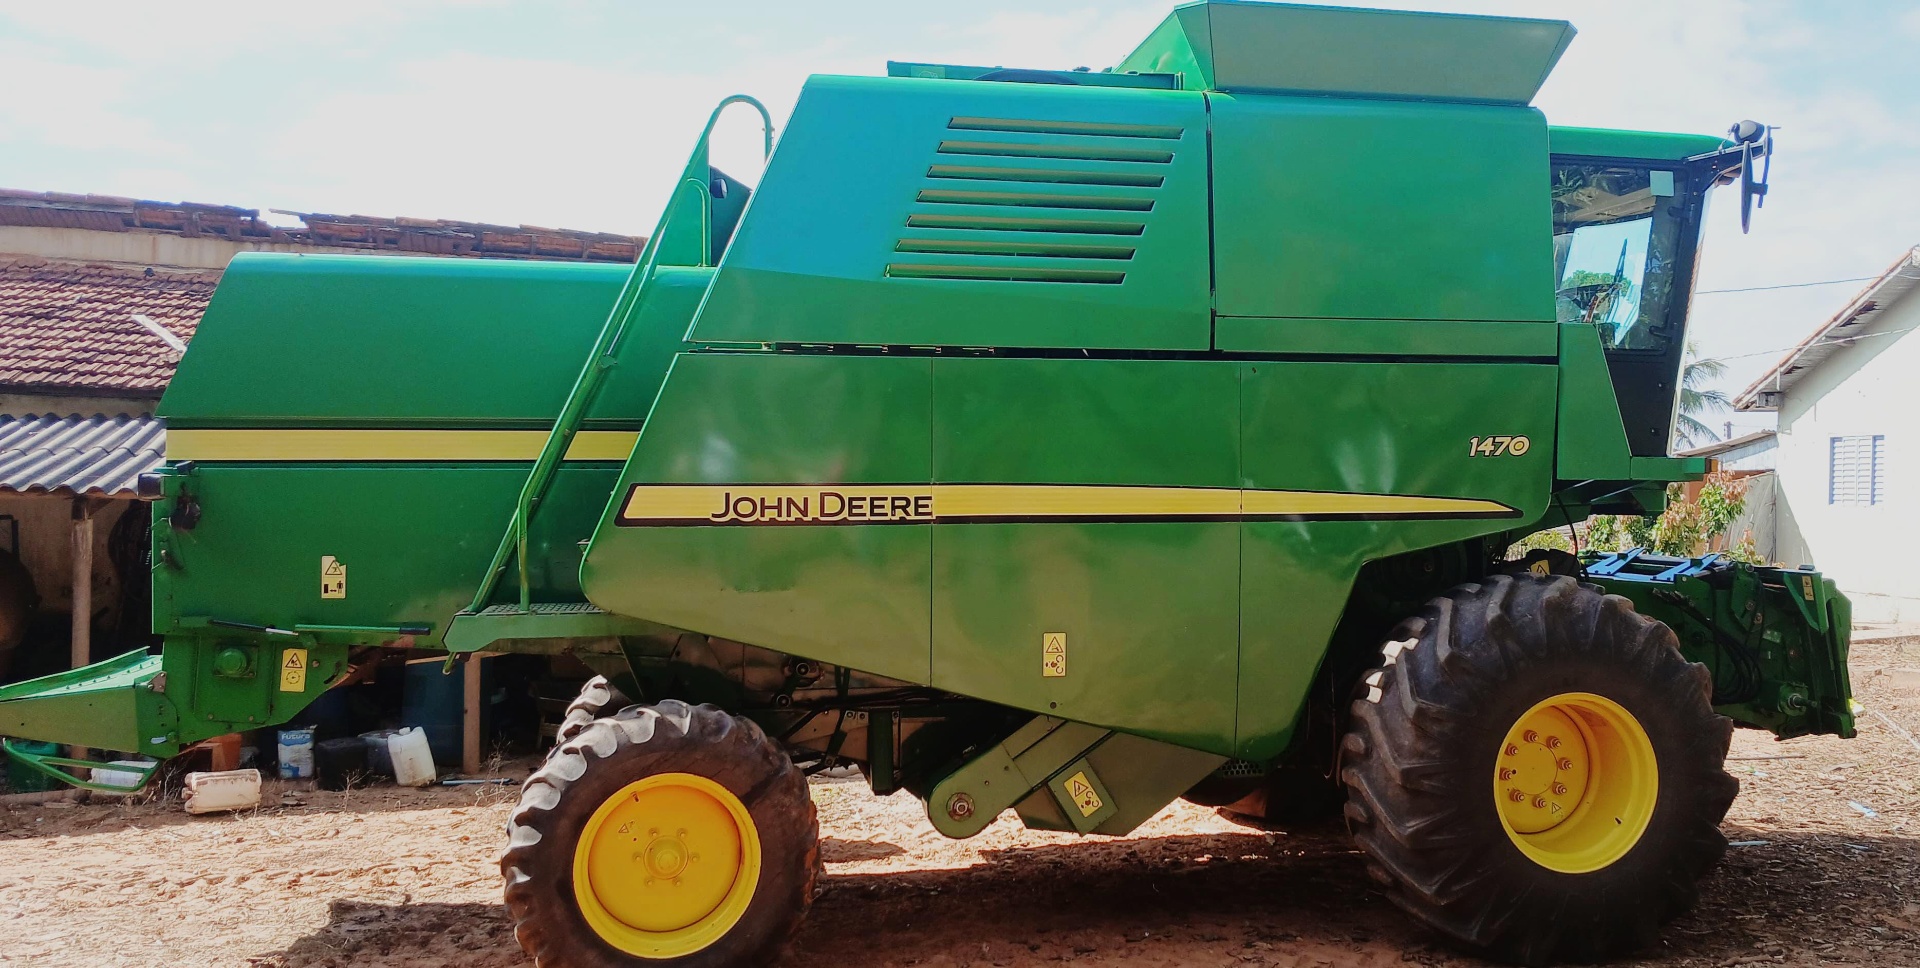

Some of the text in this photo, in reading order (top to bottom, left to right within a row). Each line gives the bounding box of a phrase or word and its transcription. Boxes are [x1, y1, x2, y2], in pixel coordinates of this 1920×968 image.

[1469, 435, 1530, 457] 1470
[711, 491, 933, 519] JOHN DEERE
